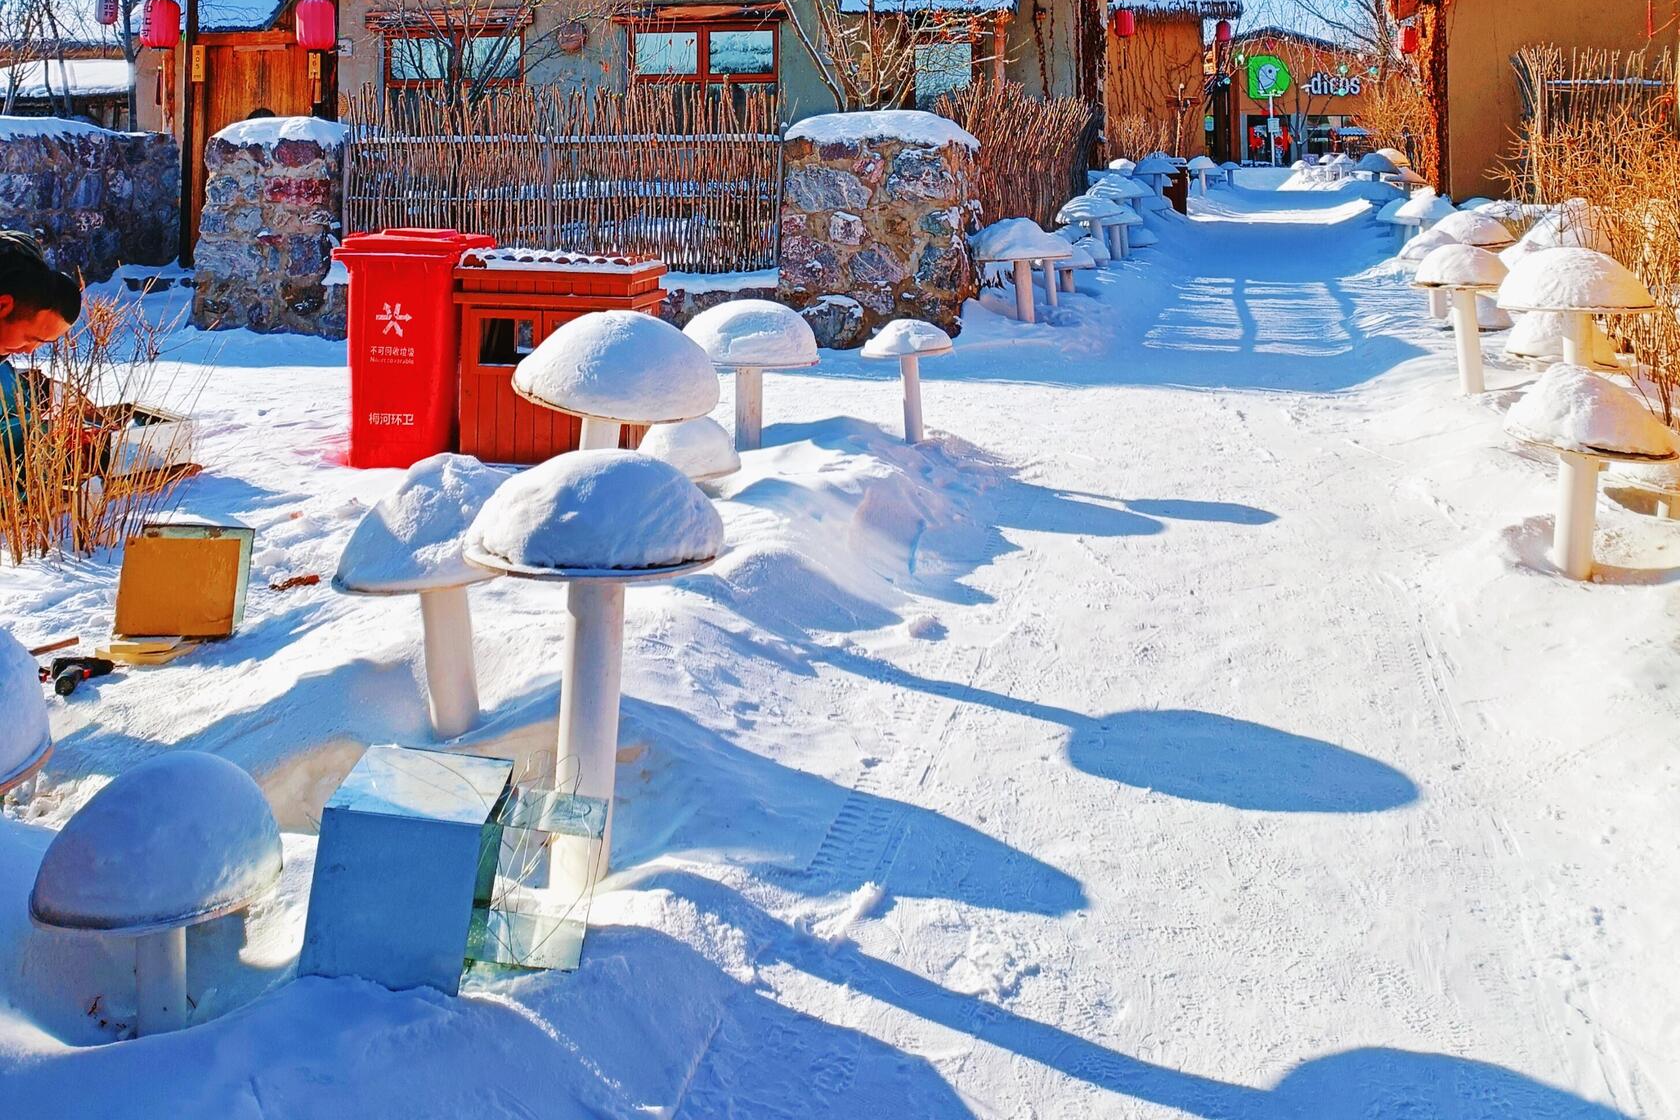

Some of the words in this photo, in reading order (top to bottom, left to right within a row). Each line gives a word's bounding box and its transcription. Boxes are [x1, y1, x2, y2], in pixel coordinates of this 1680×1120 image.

[1311, 72, 1361, 96] dicos
[369, 412, 415, 426] 梅河环卫
